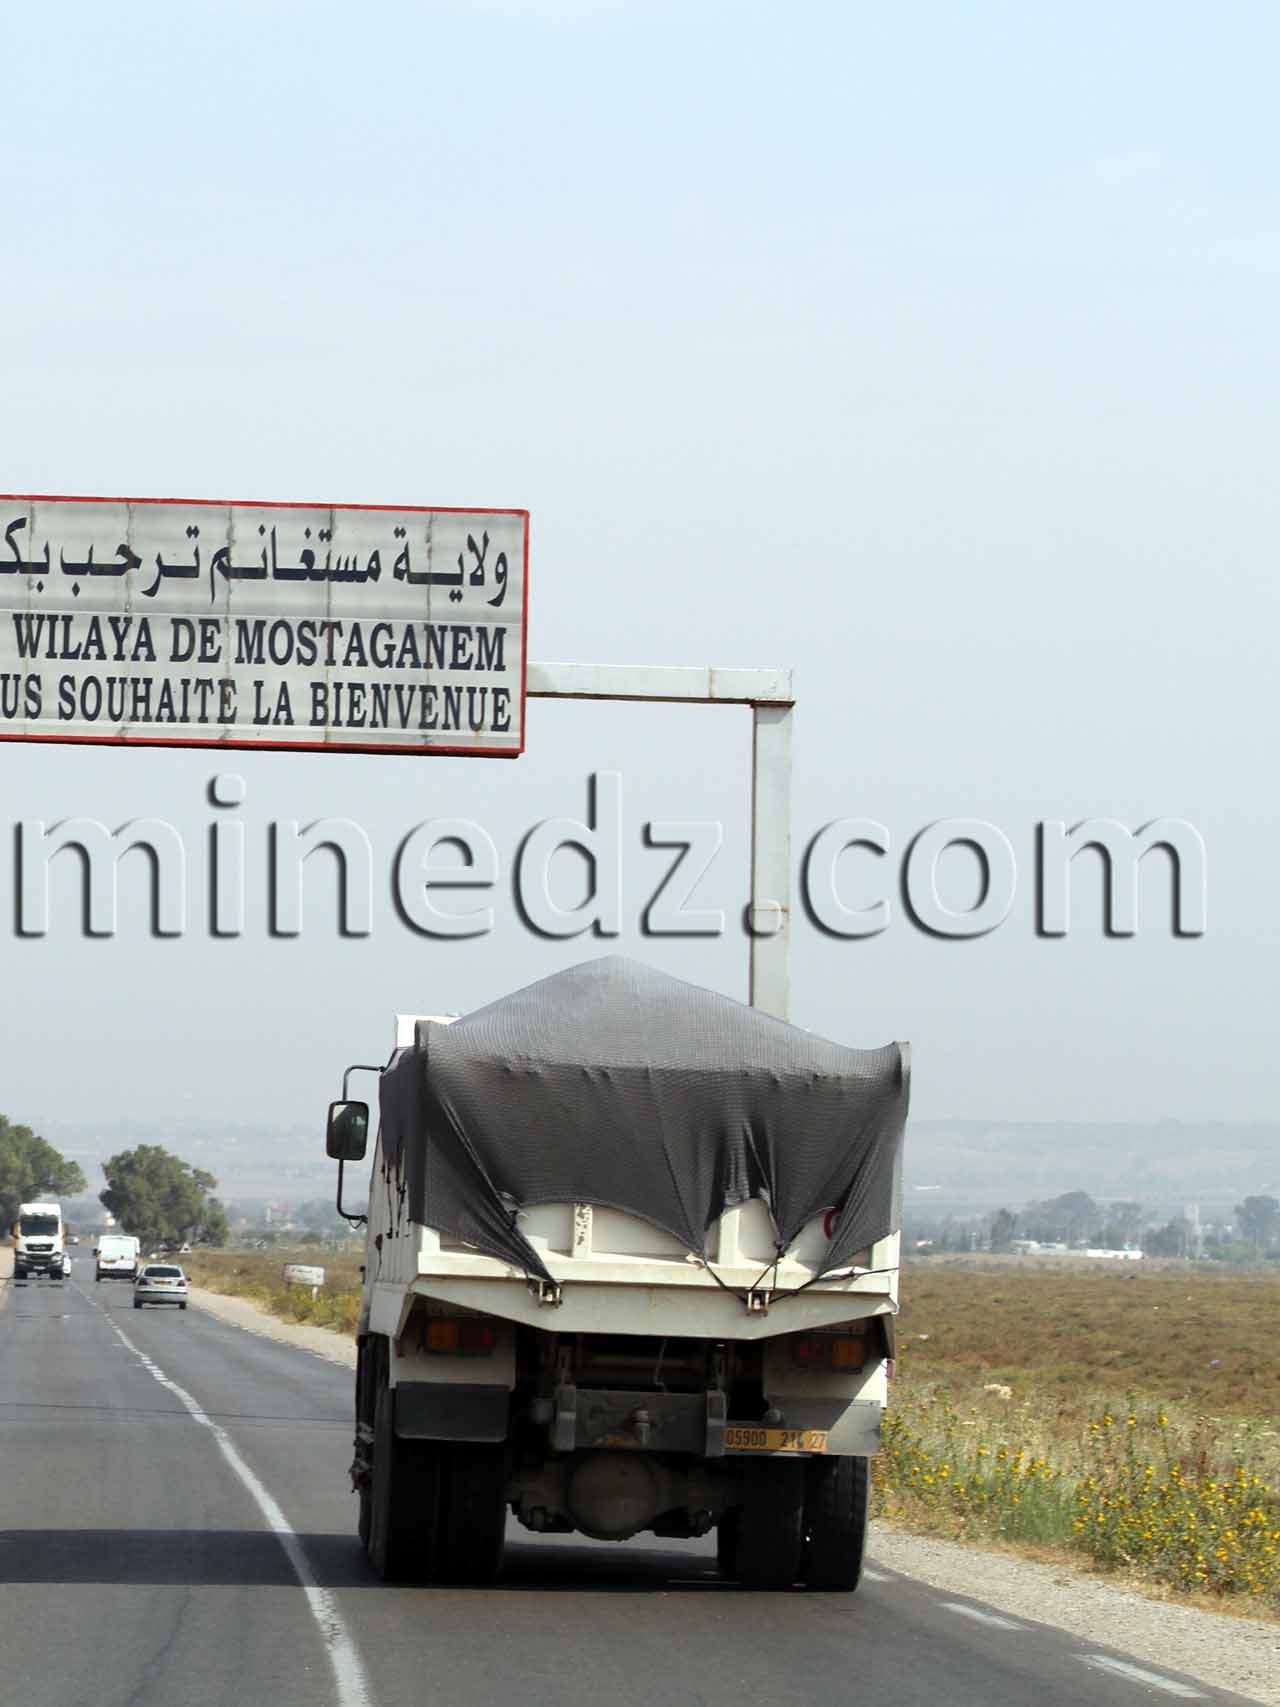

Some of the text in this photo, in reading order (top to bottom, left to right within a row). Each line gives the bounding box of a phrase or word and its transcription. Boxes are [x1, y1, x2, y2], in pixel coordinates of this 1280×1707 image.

[61, 524, 200, 598] ترحب
[210, 524, 382, 605] مستغانم
[393, 527, 508, 607] ولاية
[12, 613, 157, 662] WILAYA
[169, 617, 223, 663] DE
[234, 619, 507, 672] MOSTAGANEM
[58, 674, 238, 724] SOUHAITE
[253, 680, 295, 726] LA
[309, 681, 512, 732] BIENVENUE
